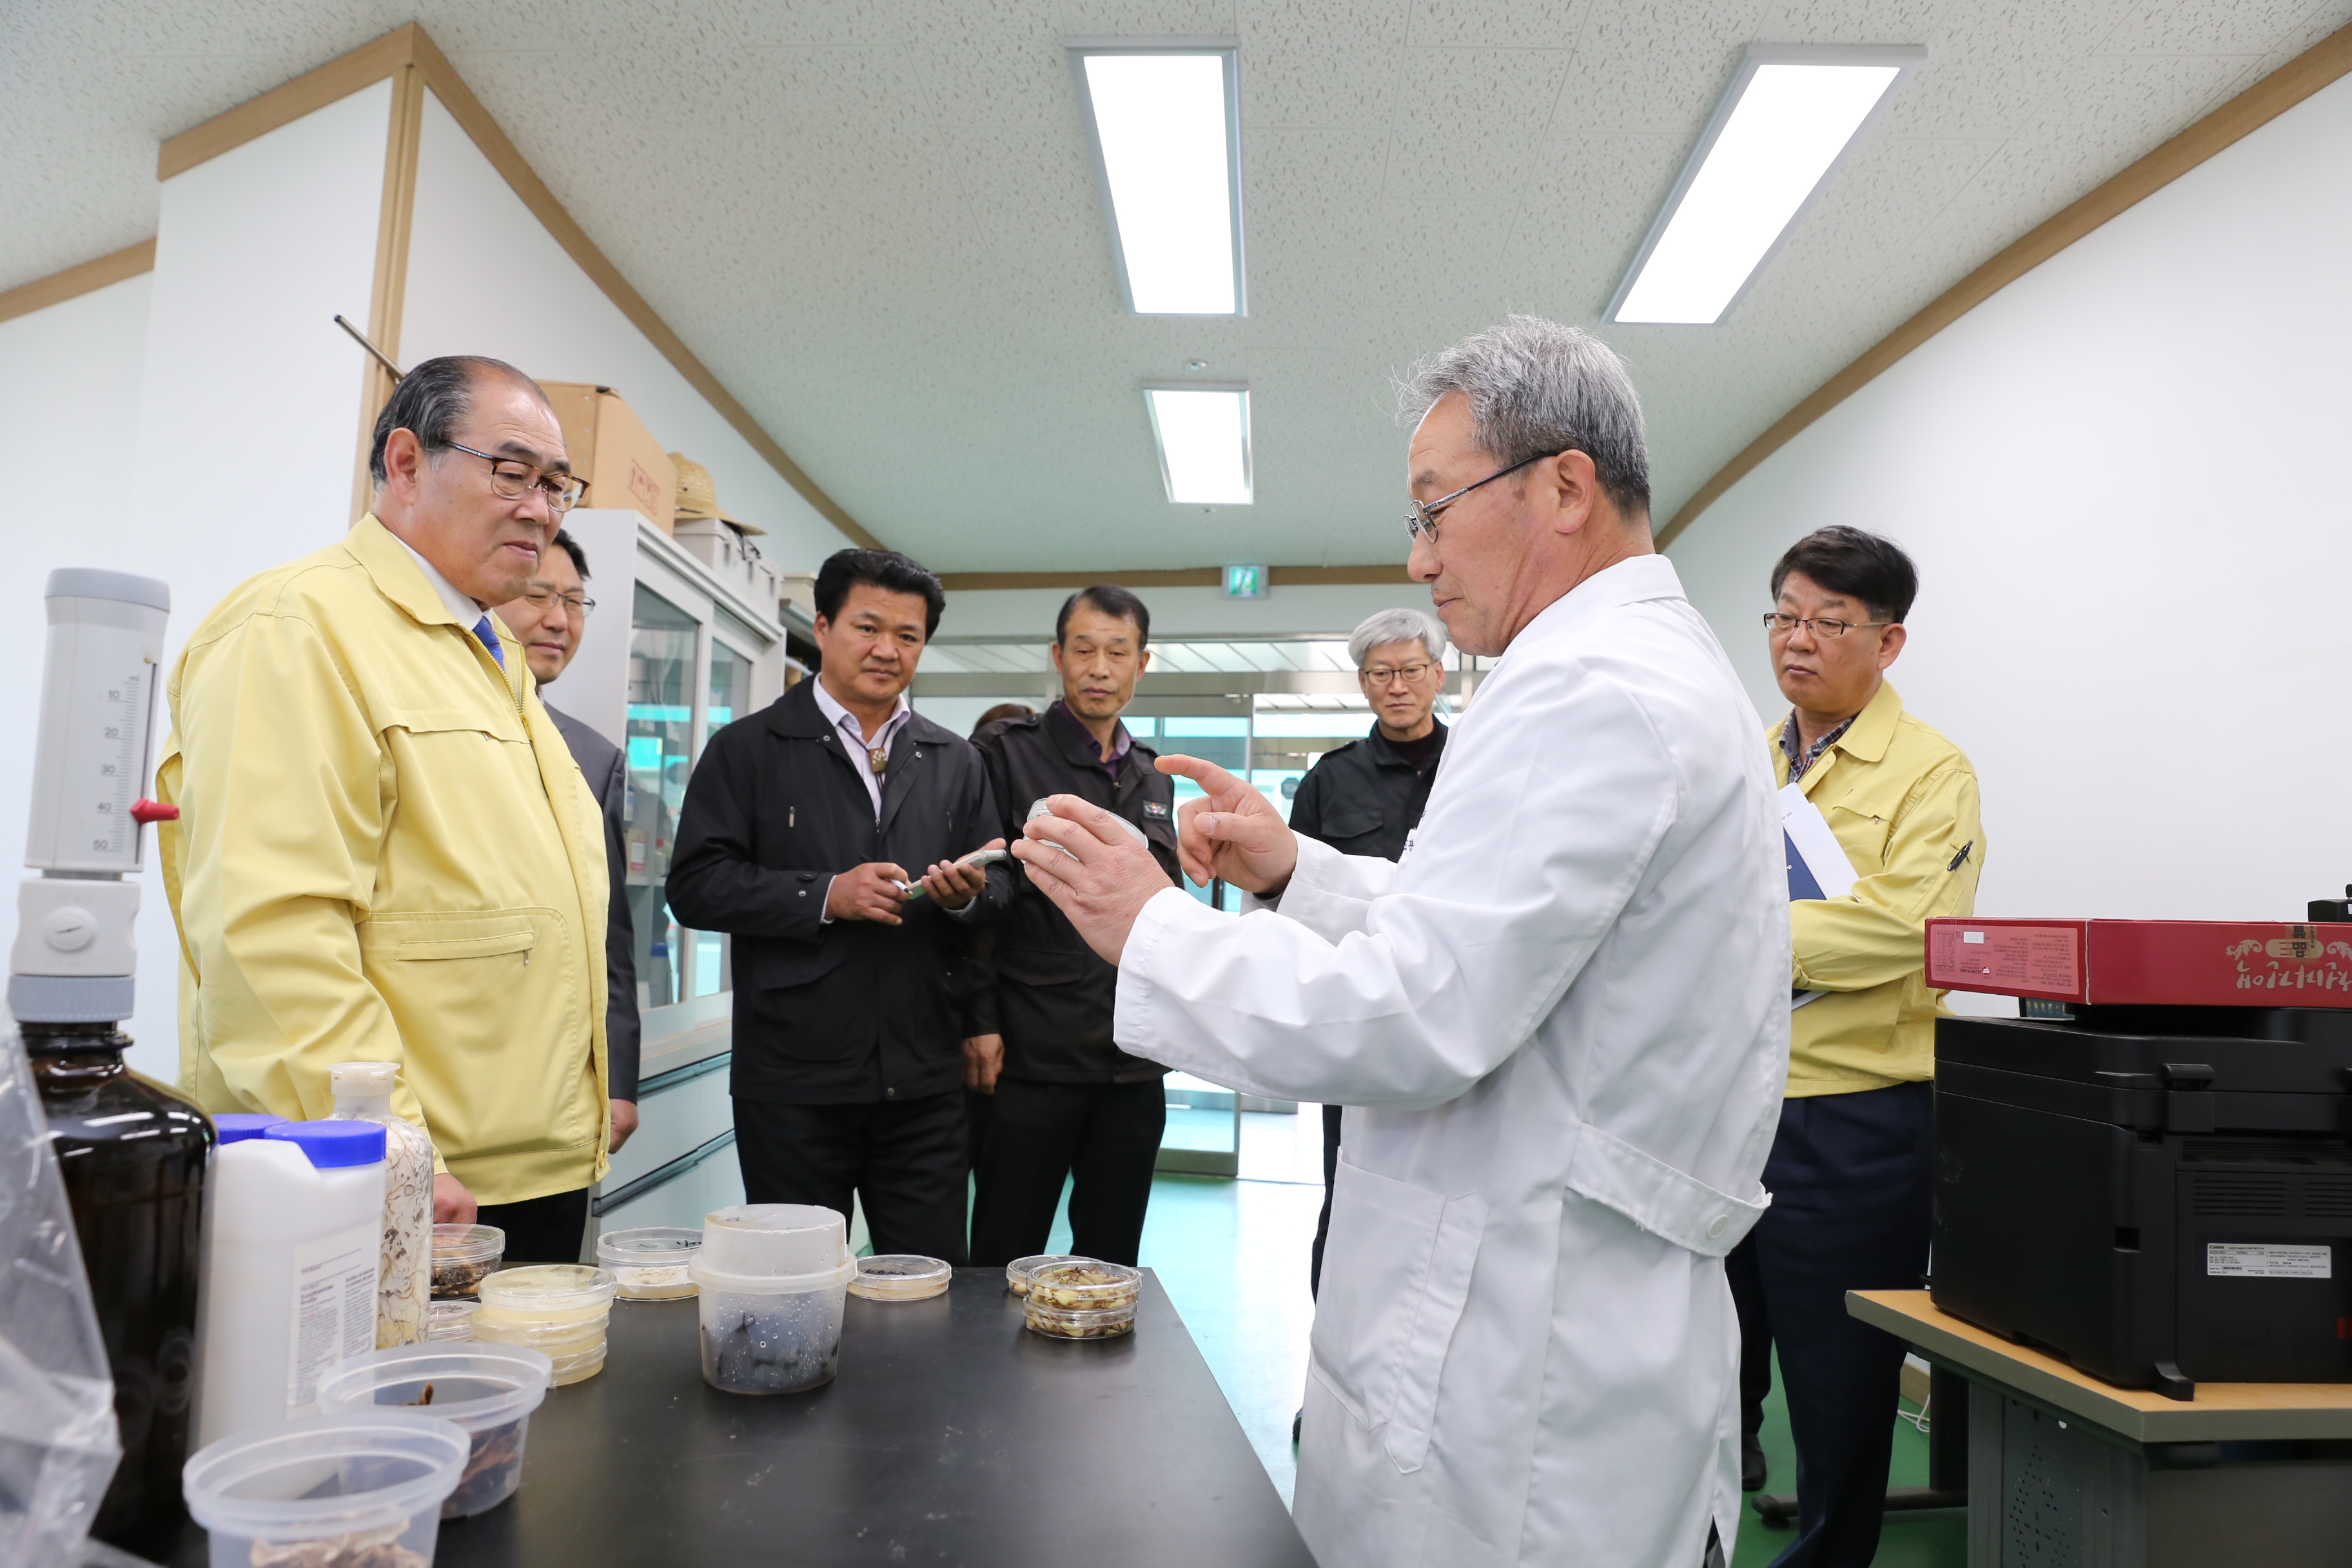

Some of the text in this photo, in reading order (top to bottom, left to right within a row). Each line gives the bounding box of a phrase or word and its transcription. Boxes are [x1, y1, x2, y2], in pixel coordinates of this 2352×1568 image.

[108, 690, 121, 699] 10
[104, 727, 119, 737] 20
[101, 764, 115, 774] 30
[97, 802, 112, 811] 40
[93, 839, 108, 849] 50
[2236, 960, 2352, 992] 천마진액
